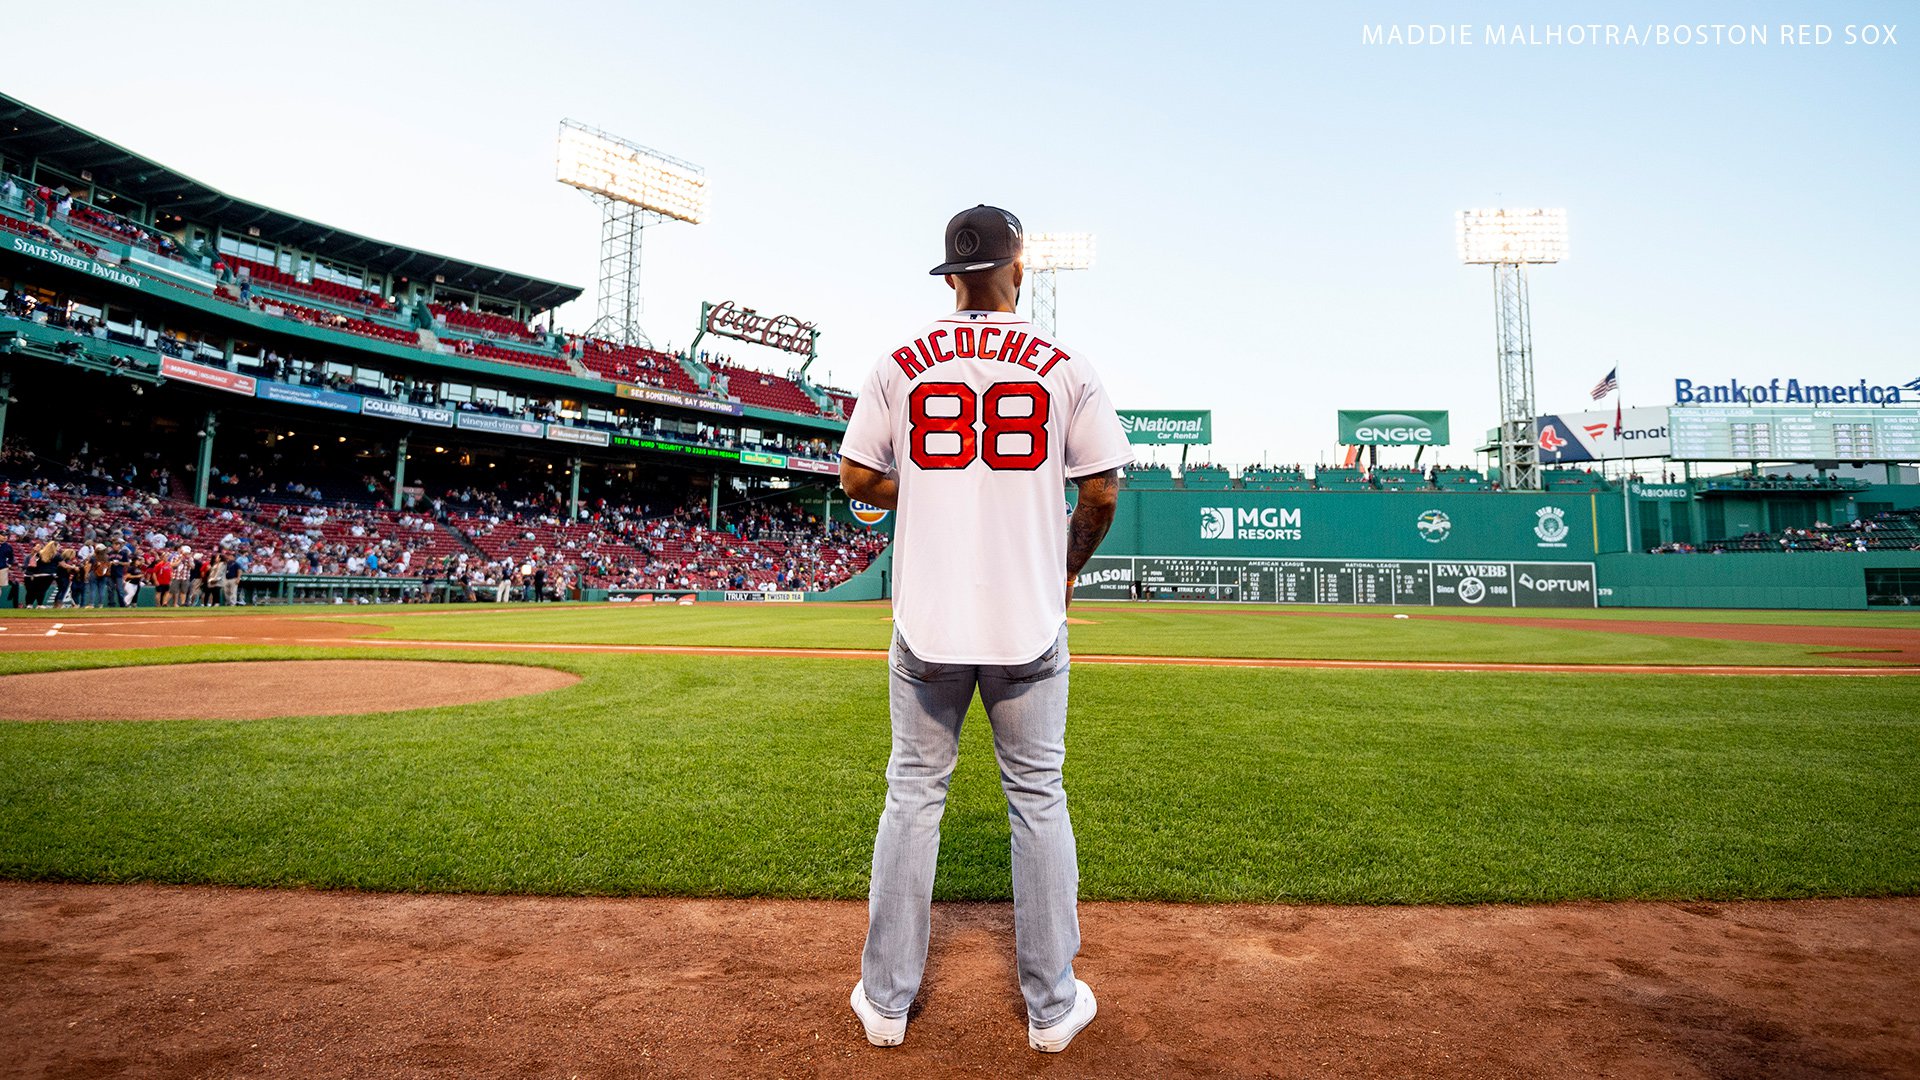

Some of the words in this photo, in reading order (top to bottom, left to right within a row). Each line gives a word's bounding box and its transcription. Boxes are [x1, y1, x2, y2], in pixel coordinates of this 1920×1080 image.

[891, 327, 1071, 380] RICOCHET
[1674, 378, 1746, 404] Bank
[1751, 378, 1780, 404] of
[1784, 378, 1901, 404] America
[630, 389, 644, 398] SEE
[685, 398, 698, 406] SAY
[700, 400, 732, 412] SOMETHING
[365, 400, 419, 418] COLUMBIA
[421, 410, 449, 422] TECH
[462, 416, 498, 429] vineyard
[500, 422, 519, 432] vines
[909, 382, 1050, 471] 88
[557, 430, 579, 438] Museum
[586, 433, 606, 442] Science
[614, 437, 628, 445] TEXT
[641, 440, 655, 448] WORD
[719, 450, 740, 459] MESSAGE
[1640, 489, 1687, 498] ABIOMED
[1238, 508, 1301, 528] MGM
[1238, 529, 1302, 540] RESORTS
[1437, 565, 1463, 577] F.W.
[1465, 565, 1507, 577] WEBB
[1437, 585, 1455, 594] Since
[1536, 579, 1590, 592] OPTUM
